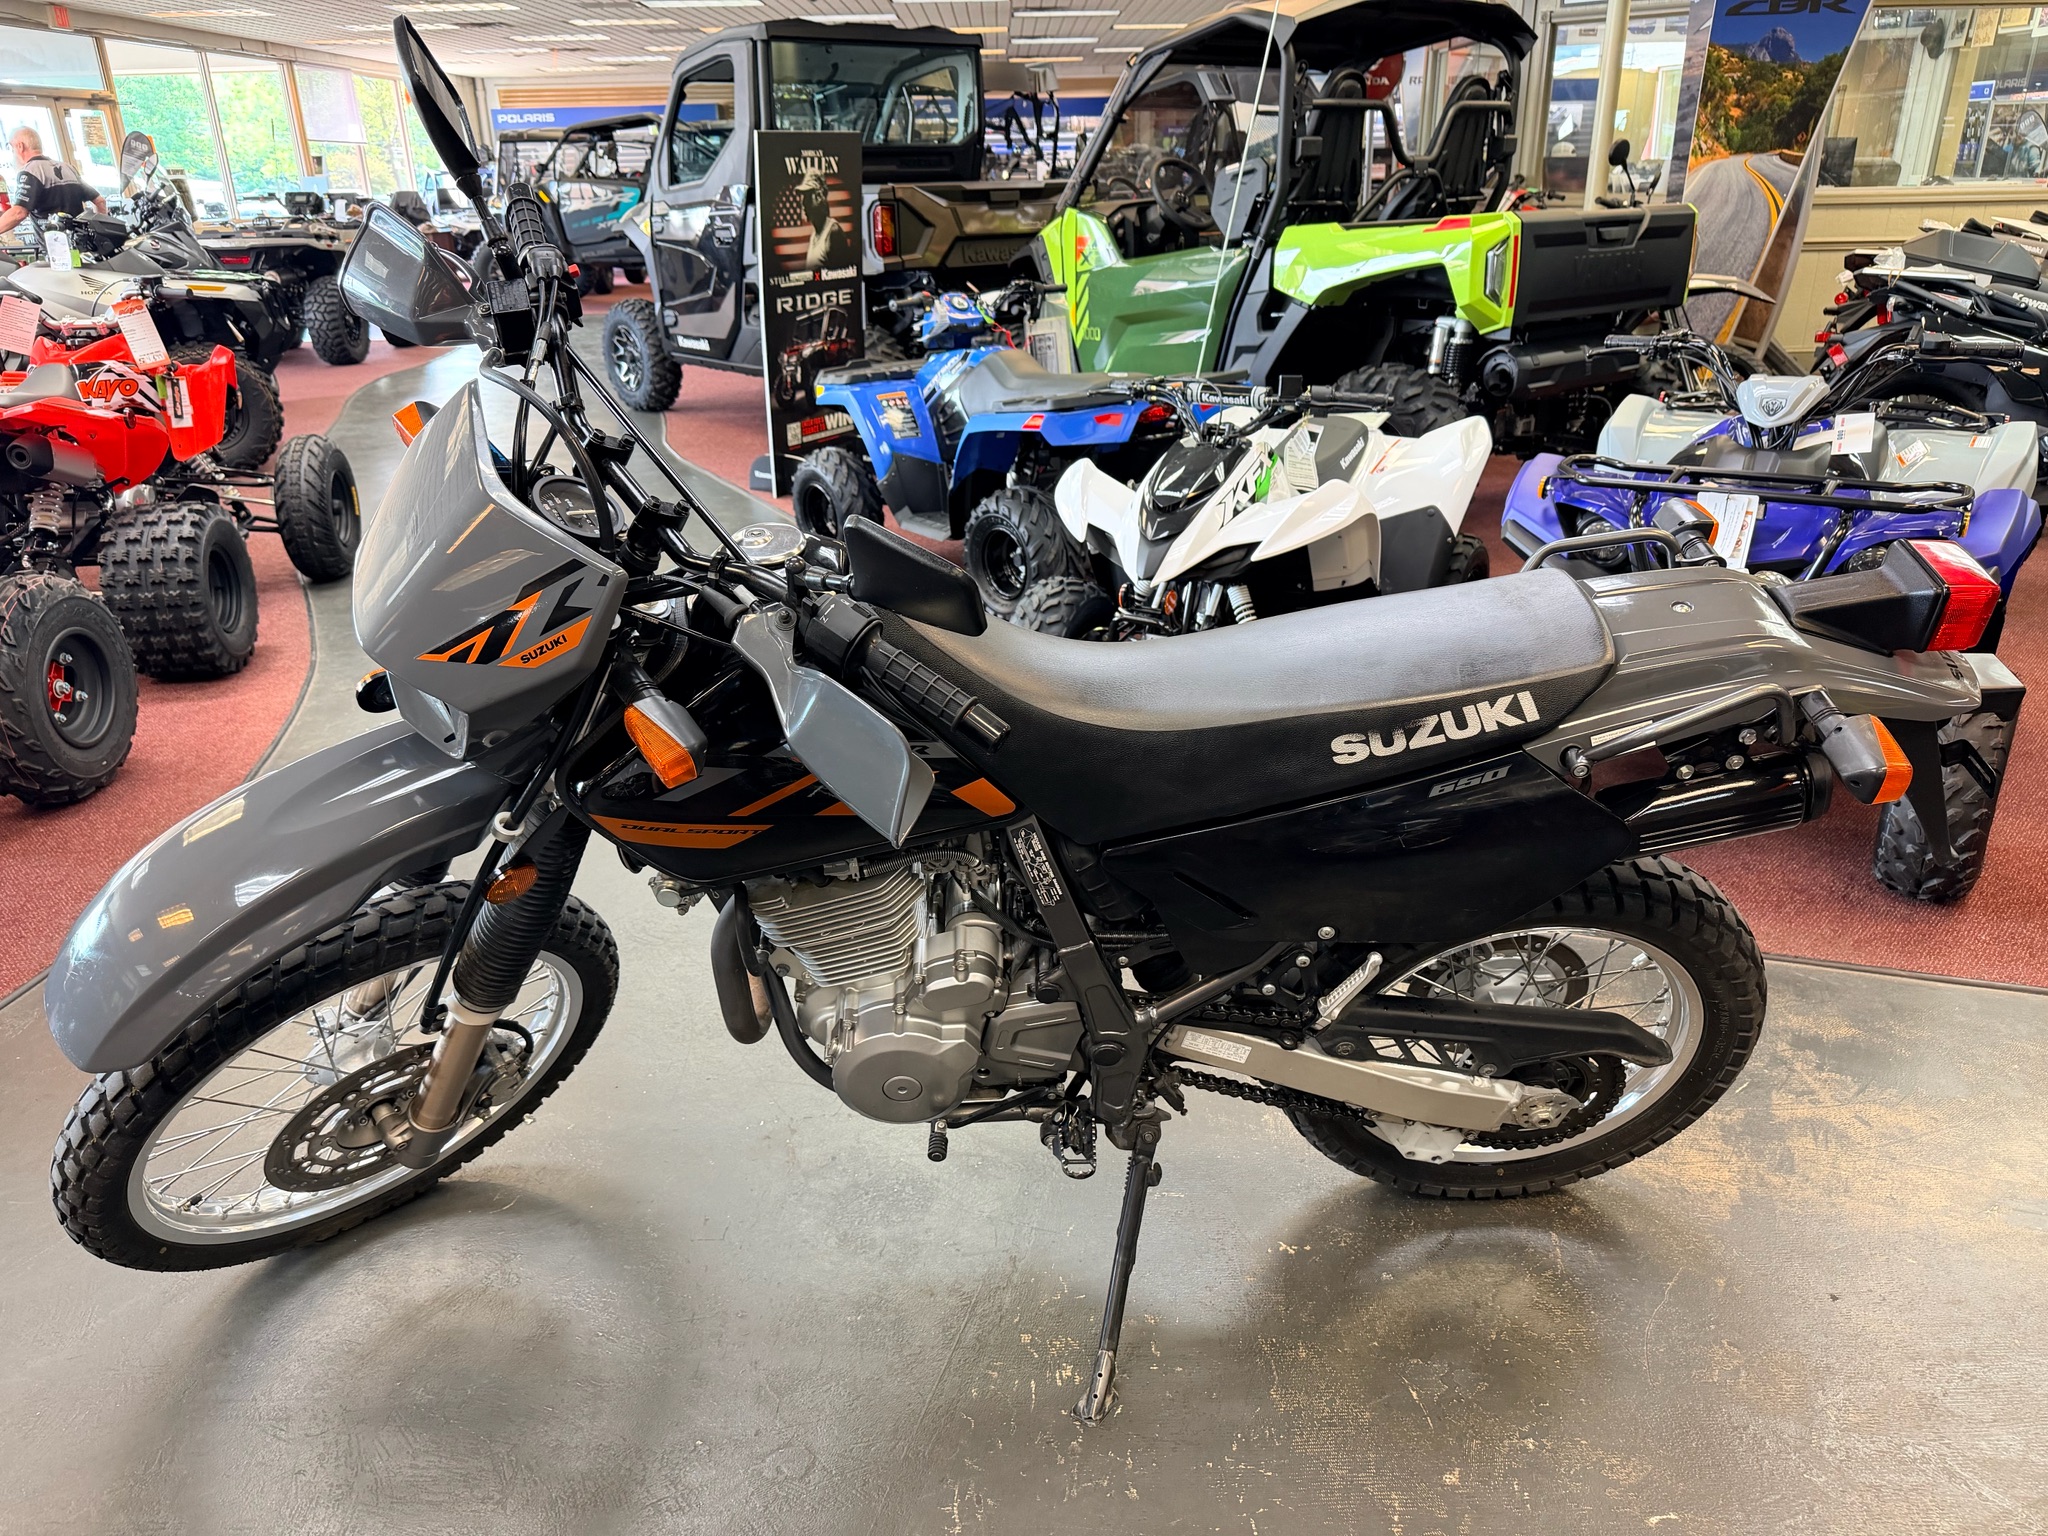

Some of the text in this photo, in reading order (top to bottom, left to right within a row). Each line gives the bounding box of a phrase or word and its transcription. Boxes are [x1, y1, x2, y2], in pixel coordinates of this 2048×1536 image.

[497, 112, 555, 124] POLARIS
[784, 157, 839, 175] WALLEN
[821, 266, 858, 281] Kawasaki
[776, 289, 853, 314] RIDGE
[77, 379, 139, 403] KAYO
[1201, 393, 1250, 406] Kawasaki
[824, 411, 854, 430] WIN
[1339, 437, 1365, 470] Kawasaki
[520, 634, 568, 664] SUZUKI
[1330, 690, 1541, 765] SUZUKI
[1428, 764, 1513, 798] 650
